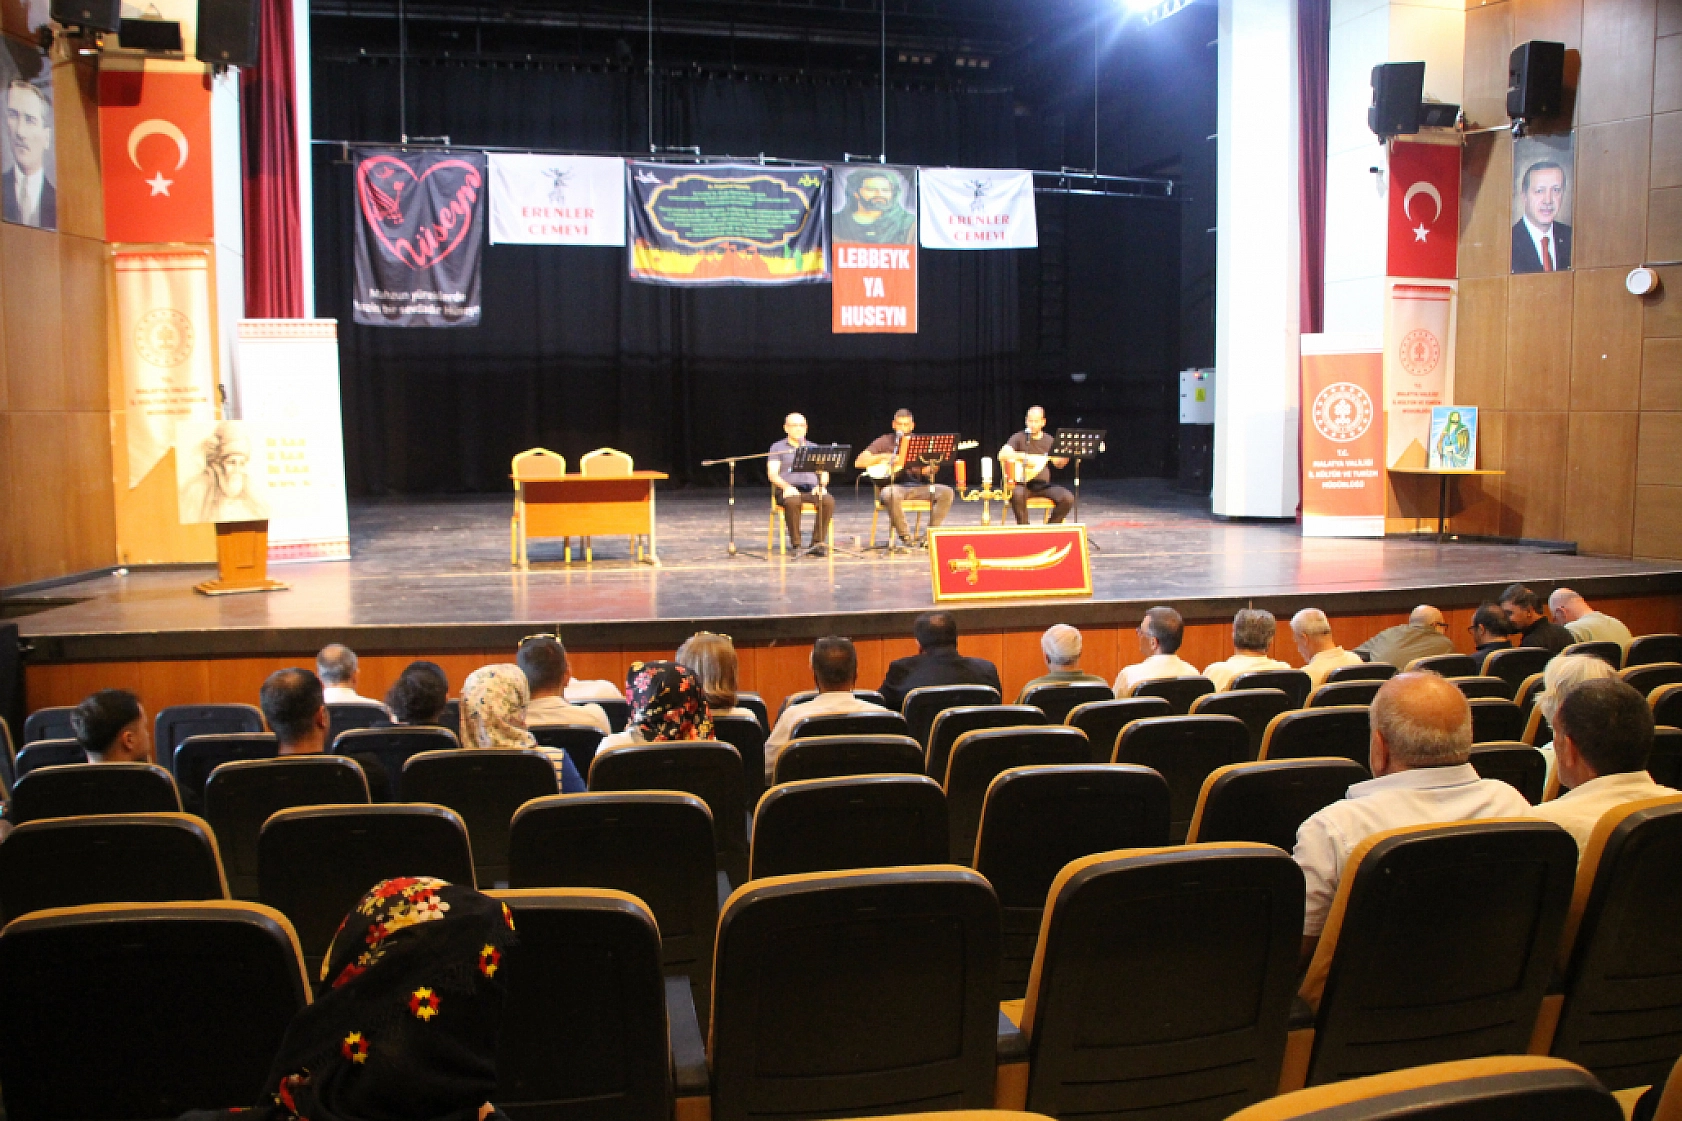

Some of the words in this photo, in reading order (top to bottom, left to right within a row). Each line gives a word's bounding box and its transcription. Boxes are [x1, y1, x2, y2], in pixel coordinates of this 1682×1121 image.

[521, 206, 595, 219] ERENLER
[948, 214, 1010, 225] ERENLER
[837, 247, 910, 270] LEBBEYK
[862, 276, 885, 298] YA
[840, 305, 907, 327] HUSEYN
